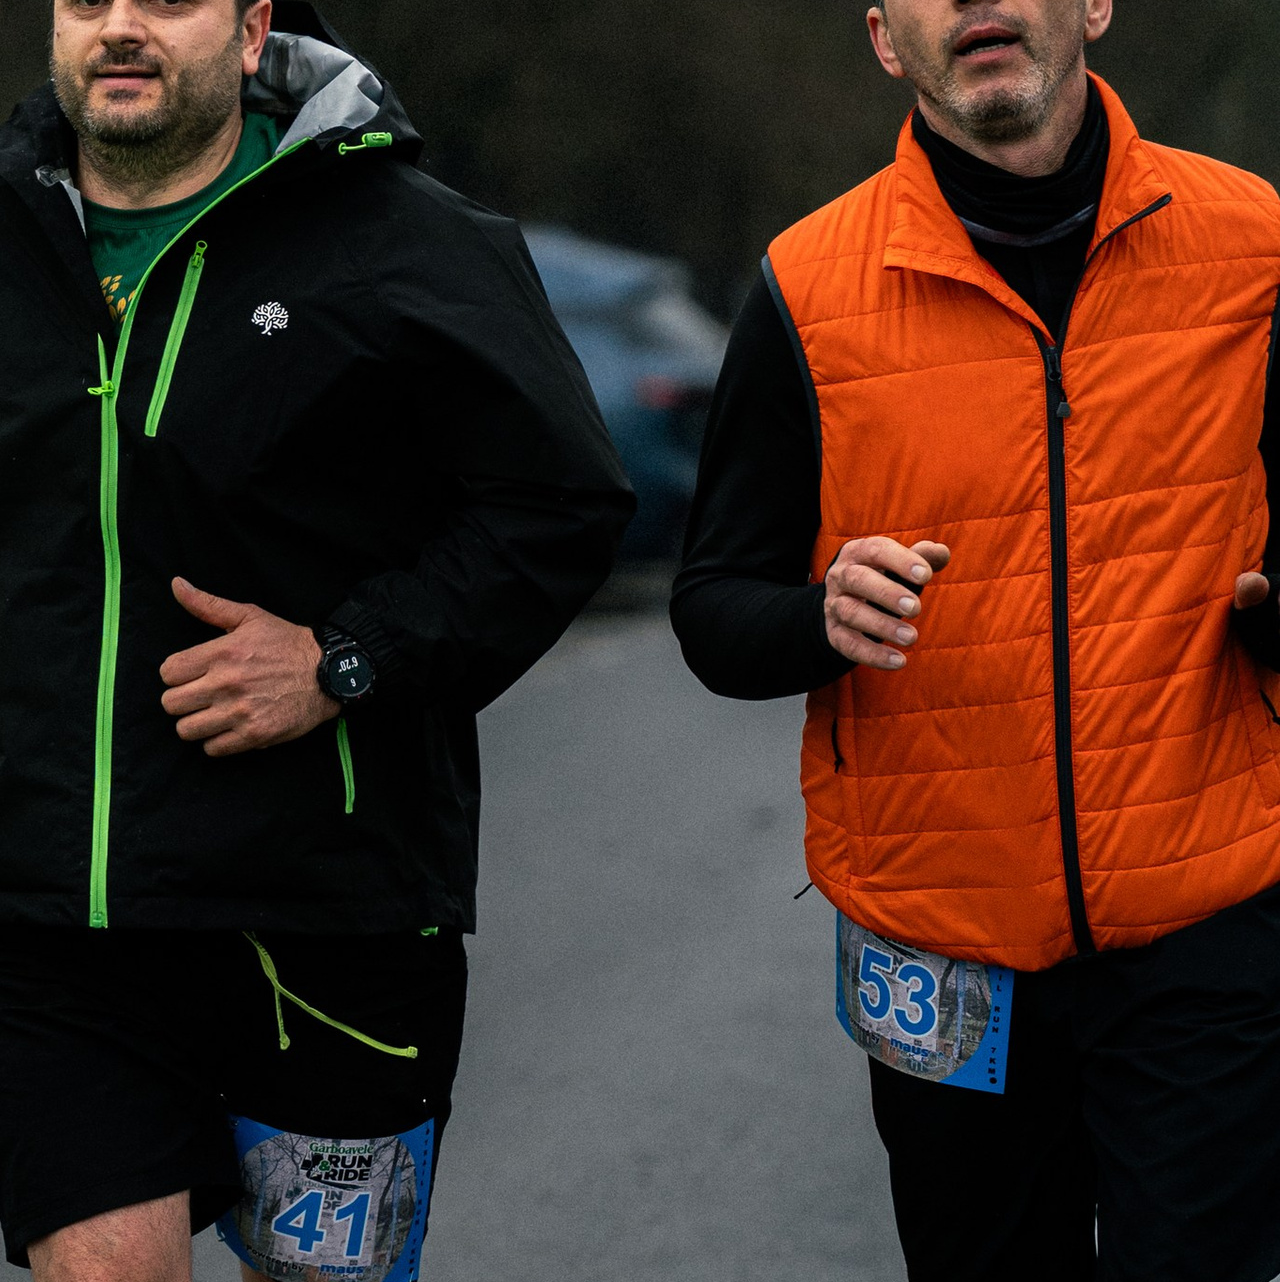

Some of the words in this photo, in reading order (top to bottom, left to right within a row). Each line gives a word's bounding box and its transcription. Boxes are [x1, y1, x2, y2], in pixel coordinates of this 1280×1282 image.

[858, 943, 938, 1038] 53
[992, 1006, 1000, 1034] RUN
[890, 1037, 929, 1057] maus
[988, 1047, 997, 1074] 7KM
[318, 1159, 331, 1172] &
[328, 1154, 373, 1169] RUN
[323, 1168, 371, 1182] RIDE
[272, 1188, 372, 1259] 41
[246, 1244, 288, 1266] Powered
[291, 1262, 305, 1273] by
[319, 1264, 365, 1274] maus
